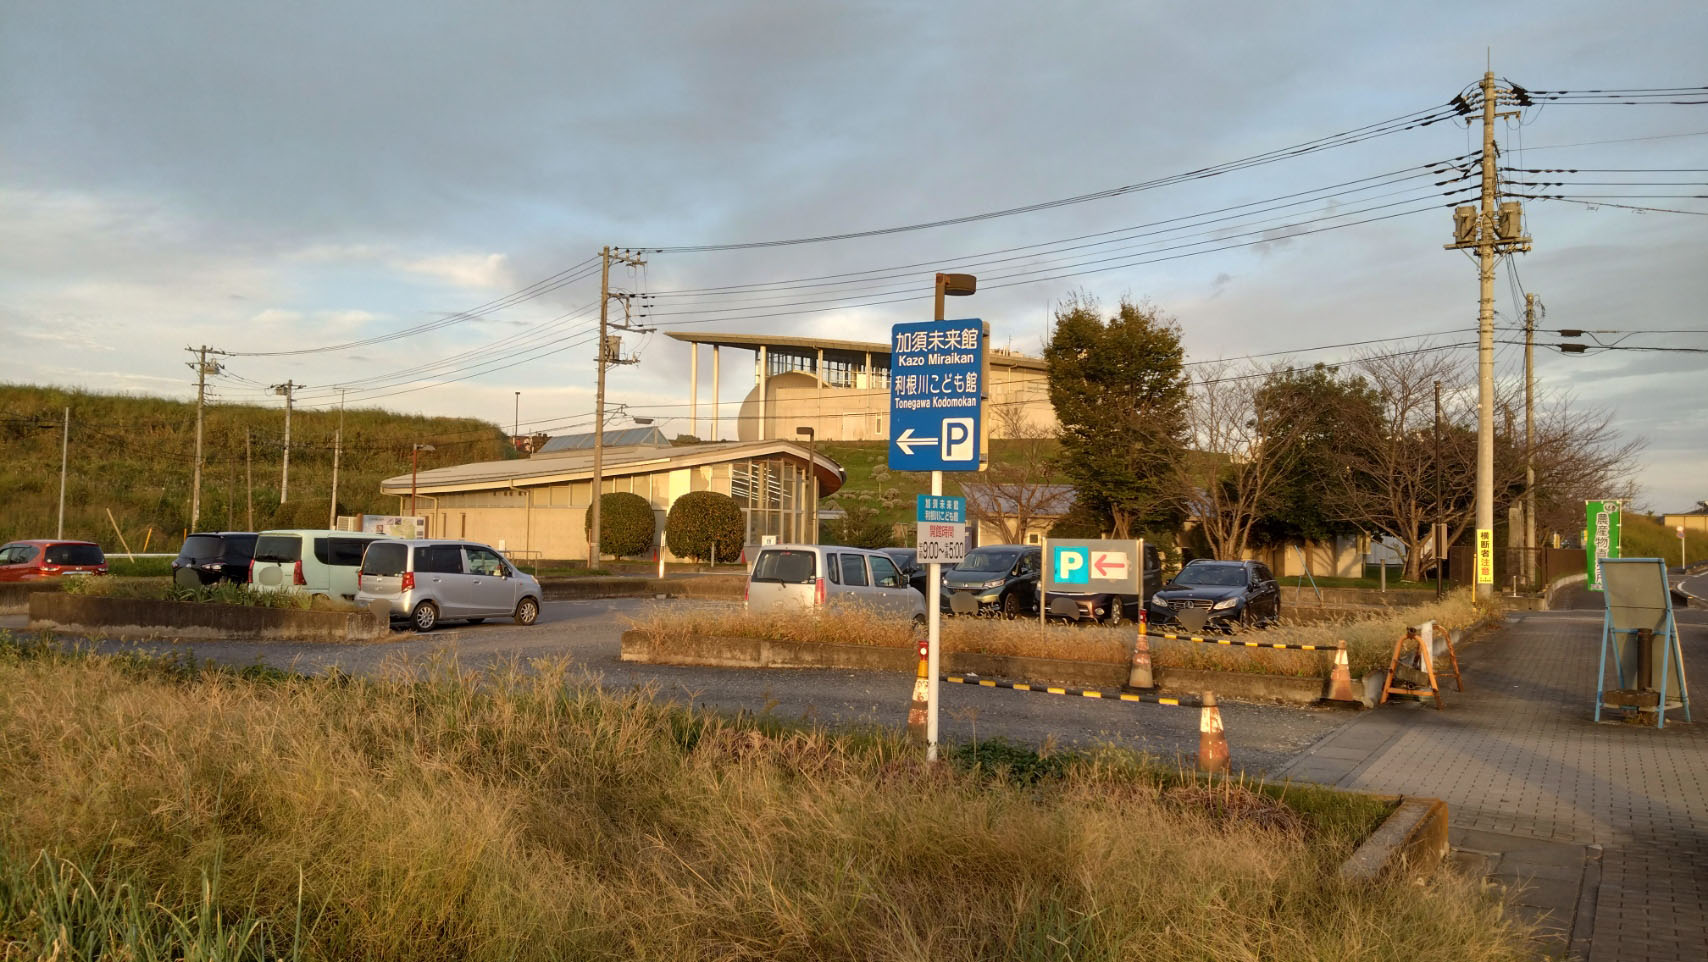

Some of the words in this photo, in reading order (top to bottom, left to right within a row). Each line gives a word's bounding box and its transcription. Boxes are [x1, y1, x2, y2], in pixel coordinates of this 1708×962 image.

[895, 328, 979, 353] 加須未来館
[898, 355, 925, 367] Kazo
[928, 353, 974, 365] Miraikan
[894, 372, 978, 396] 利根川こども館
[894, 397, 931, 411] Tonegawa
[932, 396, 977, 408] Kodomokan
[946, 422, 969, 457] P
[1060, 551, 1084, 579] P
[1480, 531, 1490, 576] 横断者注意
